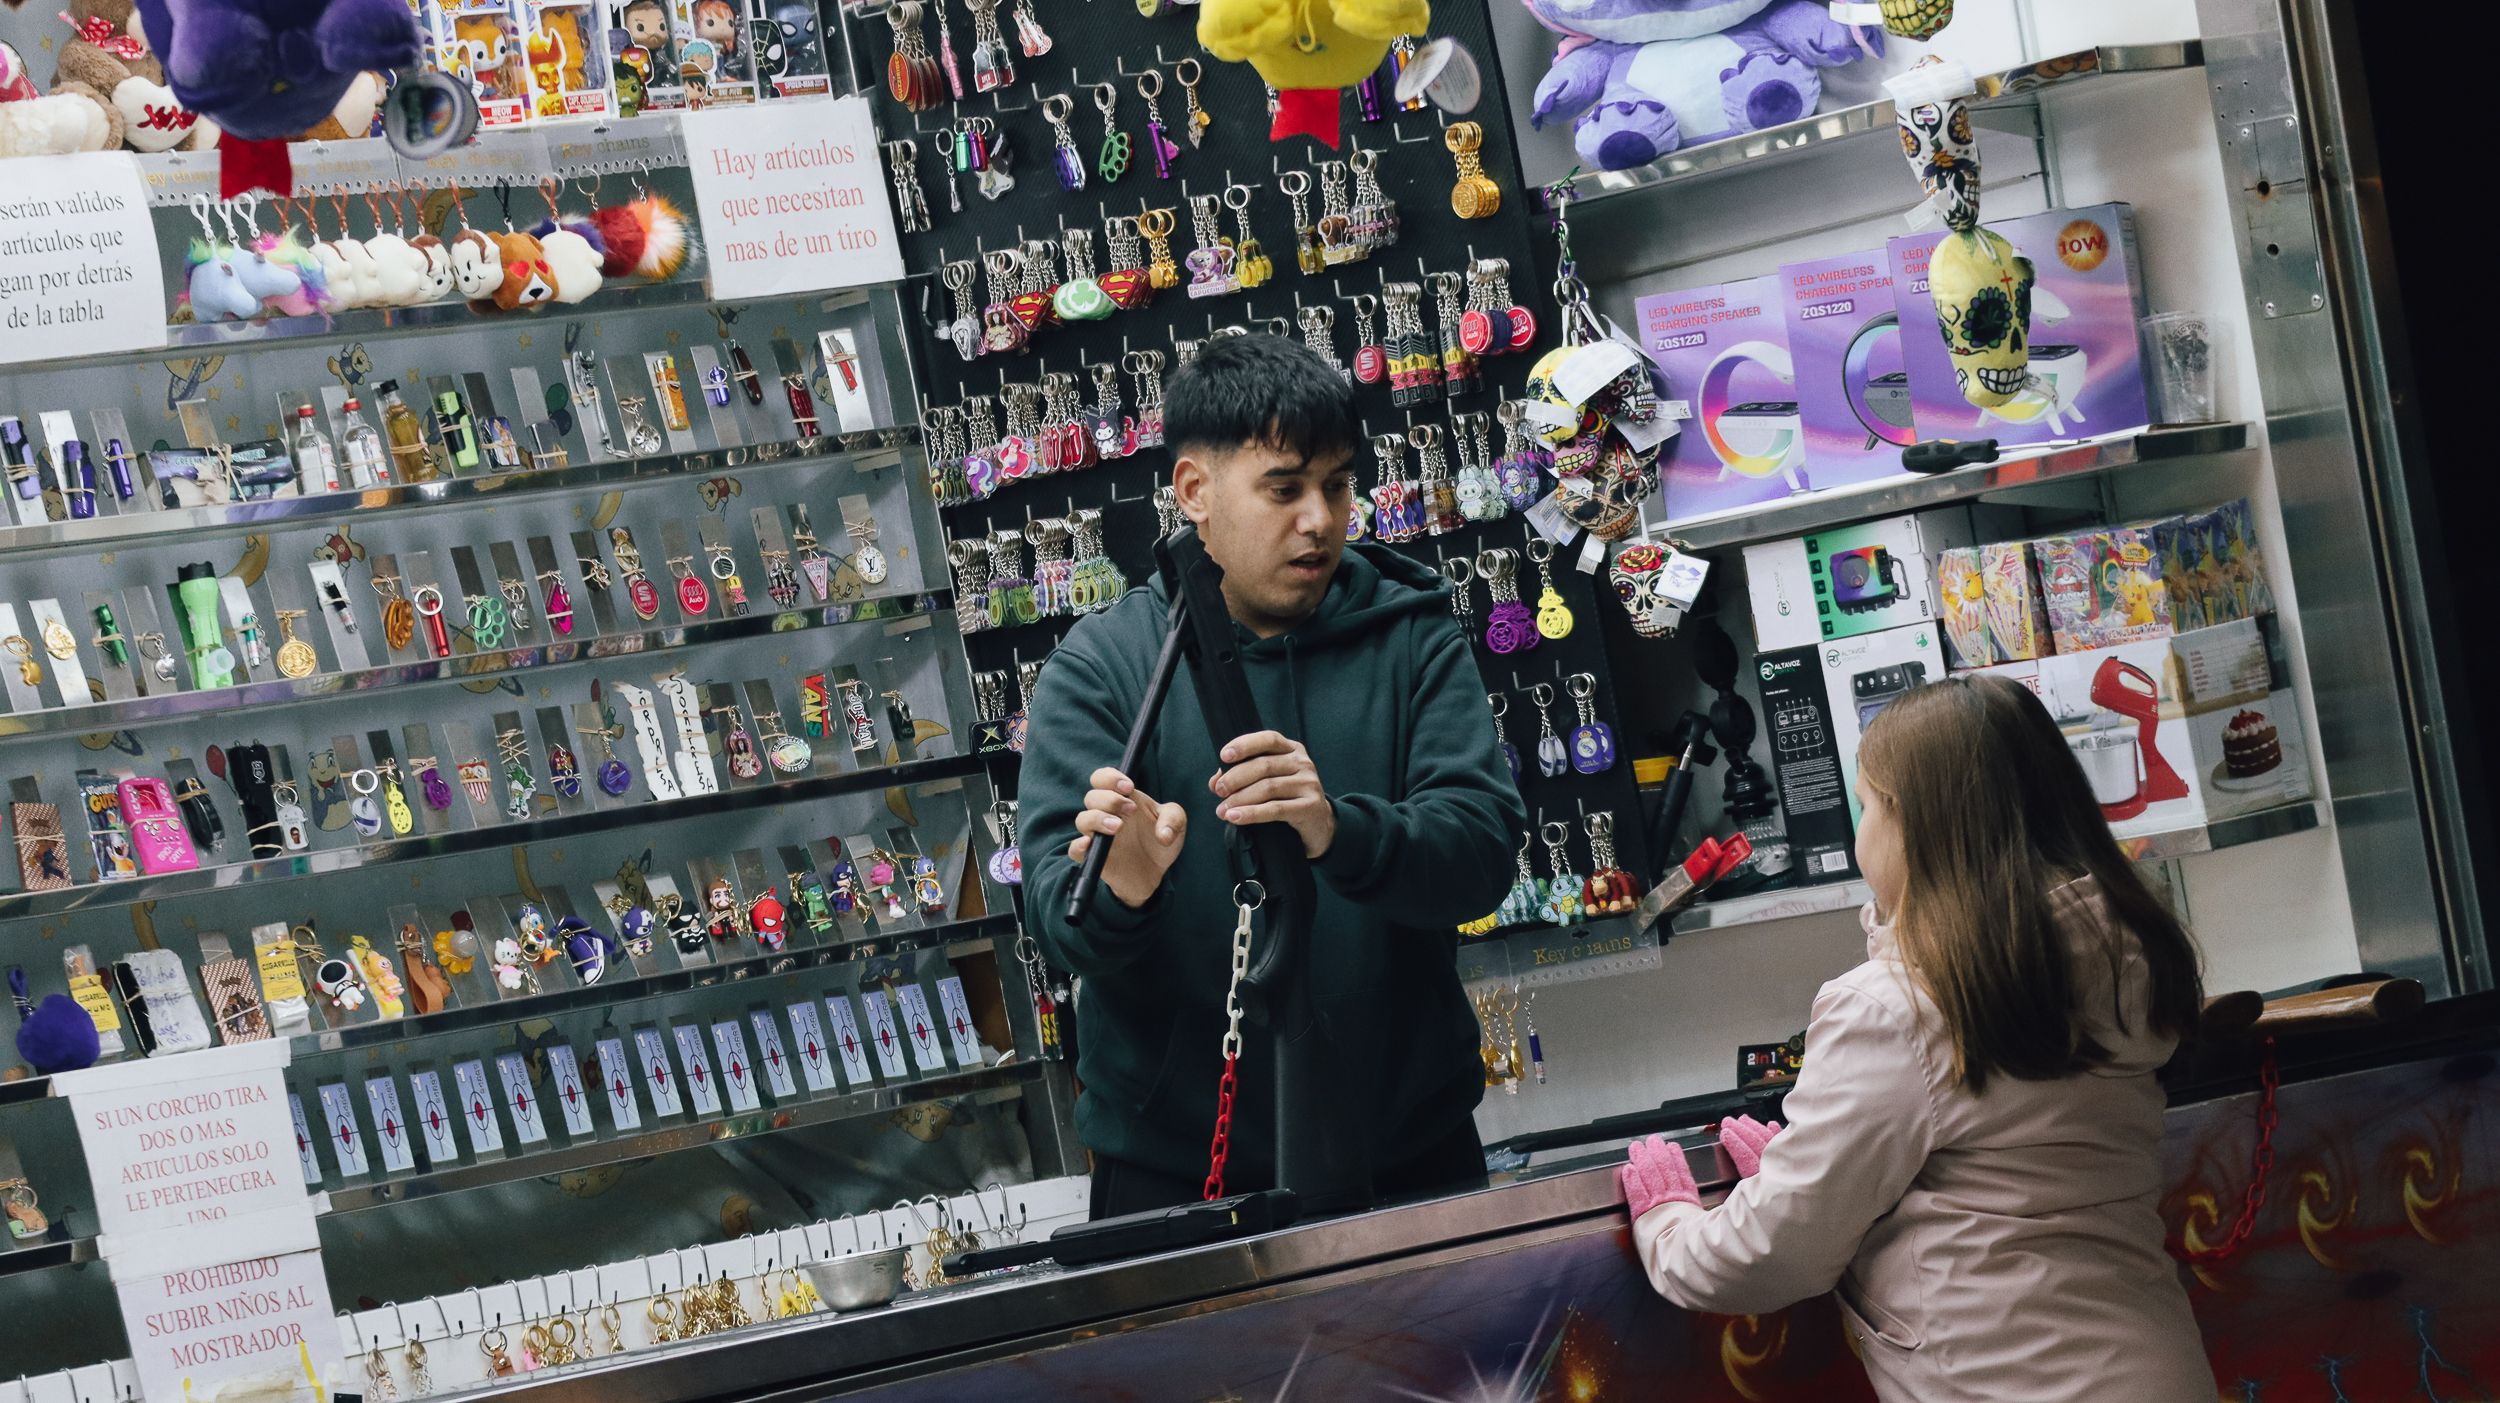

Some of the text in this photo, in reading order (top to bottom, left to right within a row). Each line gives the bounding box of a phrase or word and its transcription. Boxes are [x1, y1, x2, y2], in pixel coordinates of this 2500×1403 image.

[712, 139, 855, 180] Hay artículos
[0, 191, 125, 221] serán validos
[722, 182, 865, 226] que necesitan
[90, 230, 124, 254] que
[725, 224, 877, 262] mas de un tiro
[39, 269, 71, 296] por
[1795, 284, 1857, 300] CHARGING
[7, 298, 104, 329] de la tabla
[1651, 305, 1761, 332] CHARGING SPEAKER
[1774, 659, 1801, 670] ALTAVOZ
[803, 673, 830, 737] VANS
[978, 743, 1008, 754] XBOX
[1533, 947, 1567, 967] Key
[94, 1085, 268, 1131] SI UN CORCHO TIRA
[139, 1119, 237, 1152] DOS O MAS
[121, 1141, 269, 1184] ARTICULOS SOLO
[126, 1170, 277, 1212] LE PERTENECERA
[162, 1257, 279, 1298] PROHIBIDO
[145, 1285, 314, 1337] SUBIR NIÑOS AL
[171, 1323, 305, 1370] MOSTRADOR
